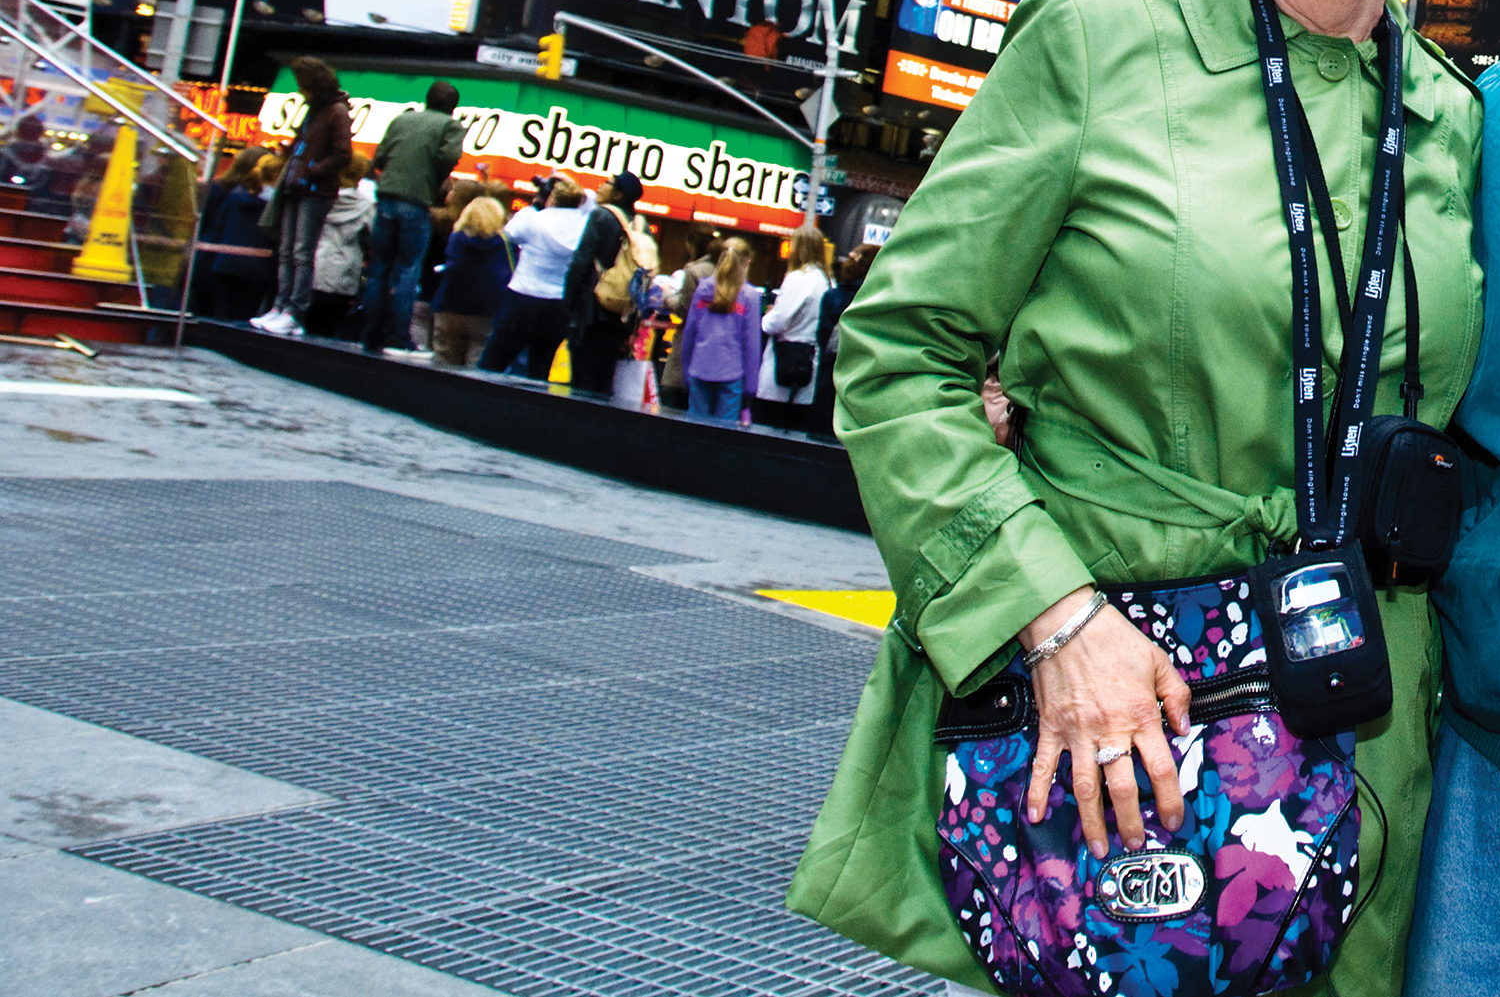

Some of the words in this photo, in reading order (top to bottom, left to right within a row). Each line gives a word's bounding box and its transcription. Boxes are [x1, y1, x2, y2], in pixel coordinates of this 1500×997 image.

[937, 10, 972, 46] ON
[1269, 57, 1283, 84] Listen
[518, 111, 664, 182] sbarro
[1383, 127, 1396, 155] Listen
[1293, 203, 1305, 231] Listen
[1365, 270, 1381, 299] Listen
[1302, 368, 1317, 400] Listen
[1353, 388, 1362, 409] Don't
[1362, 339, 1370, 362] single
[1341, 425, 1358, 457] Listen
